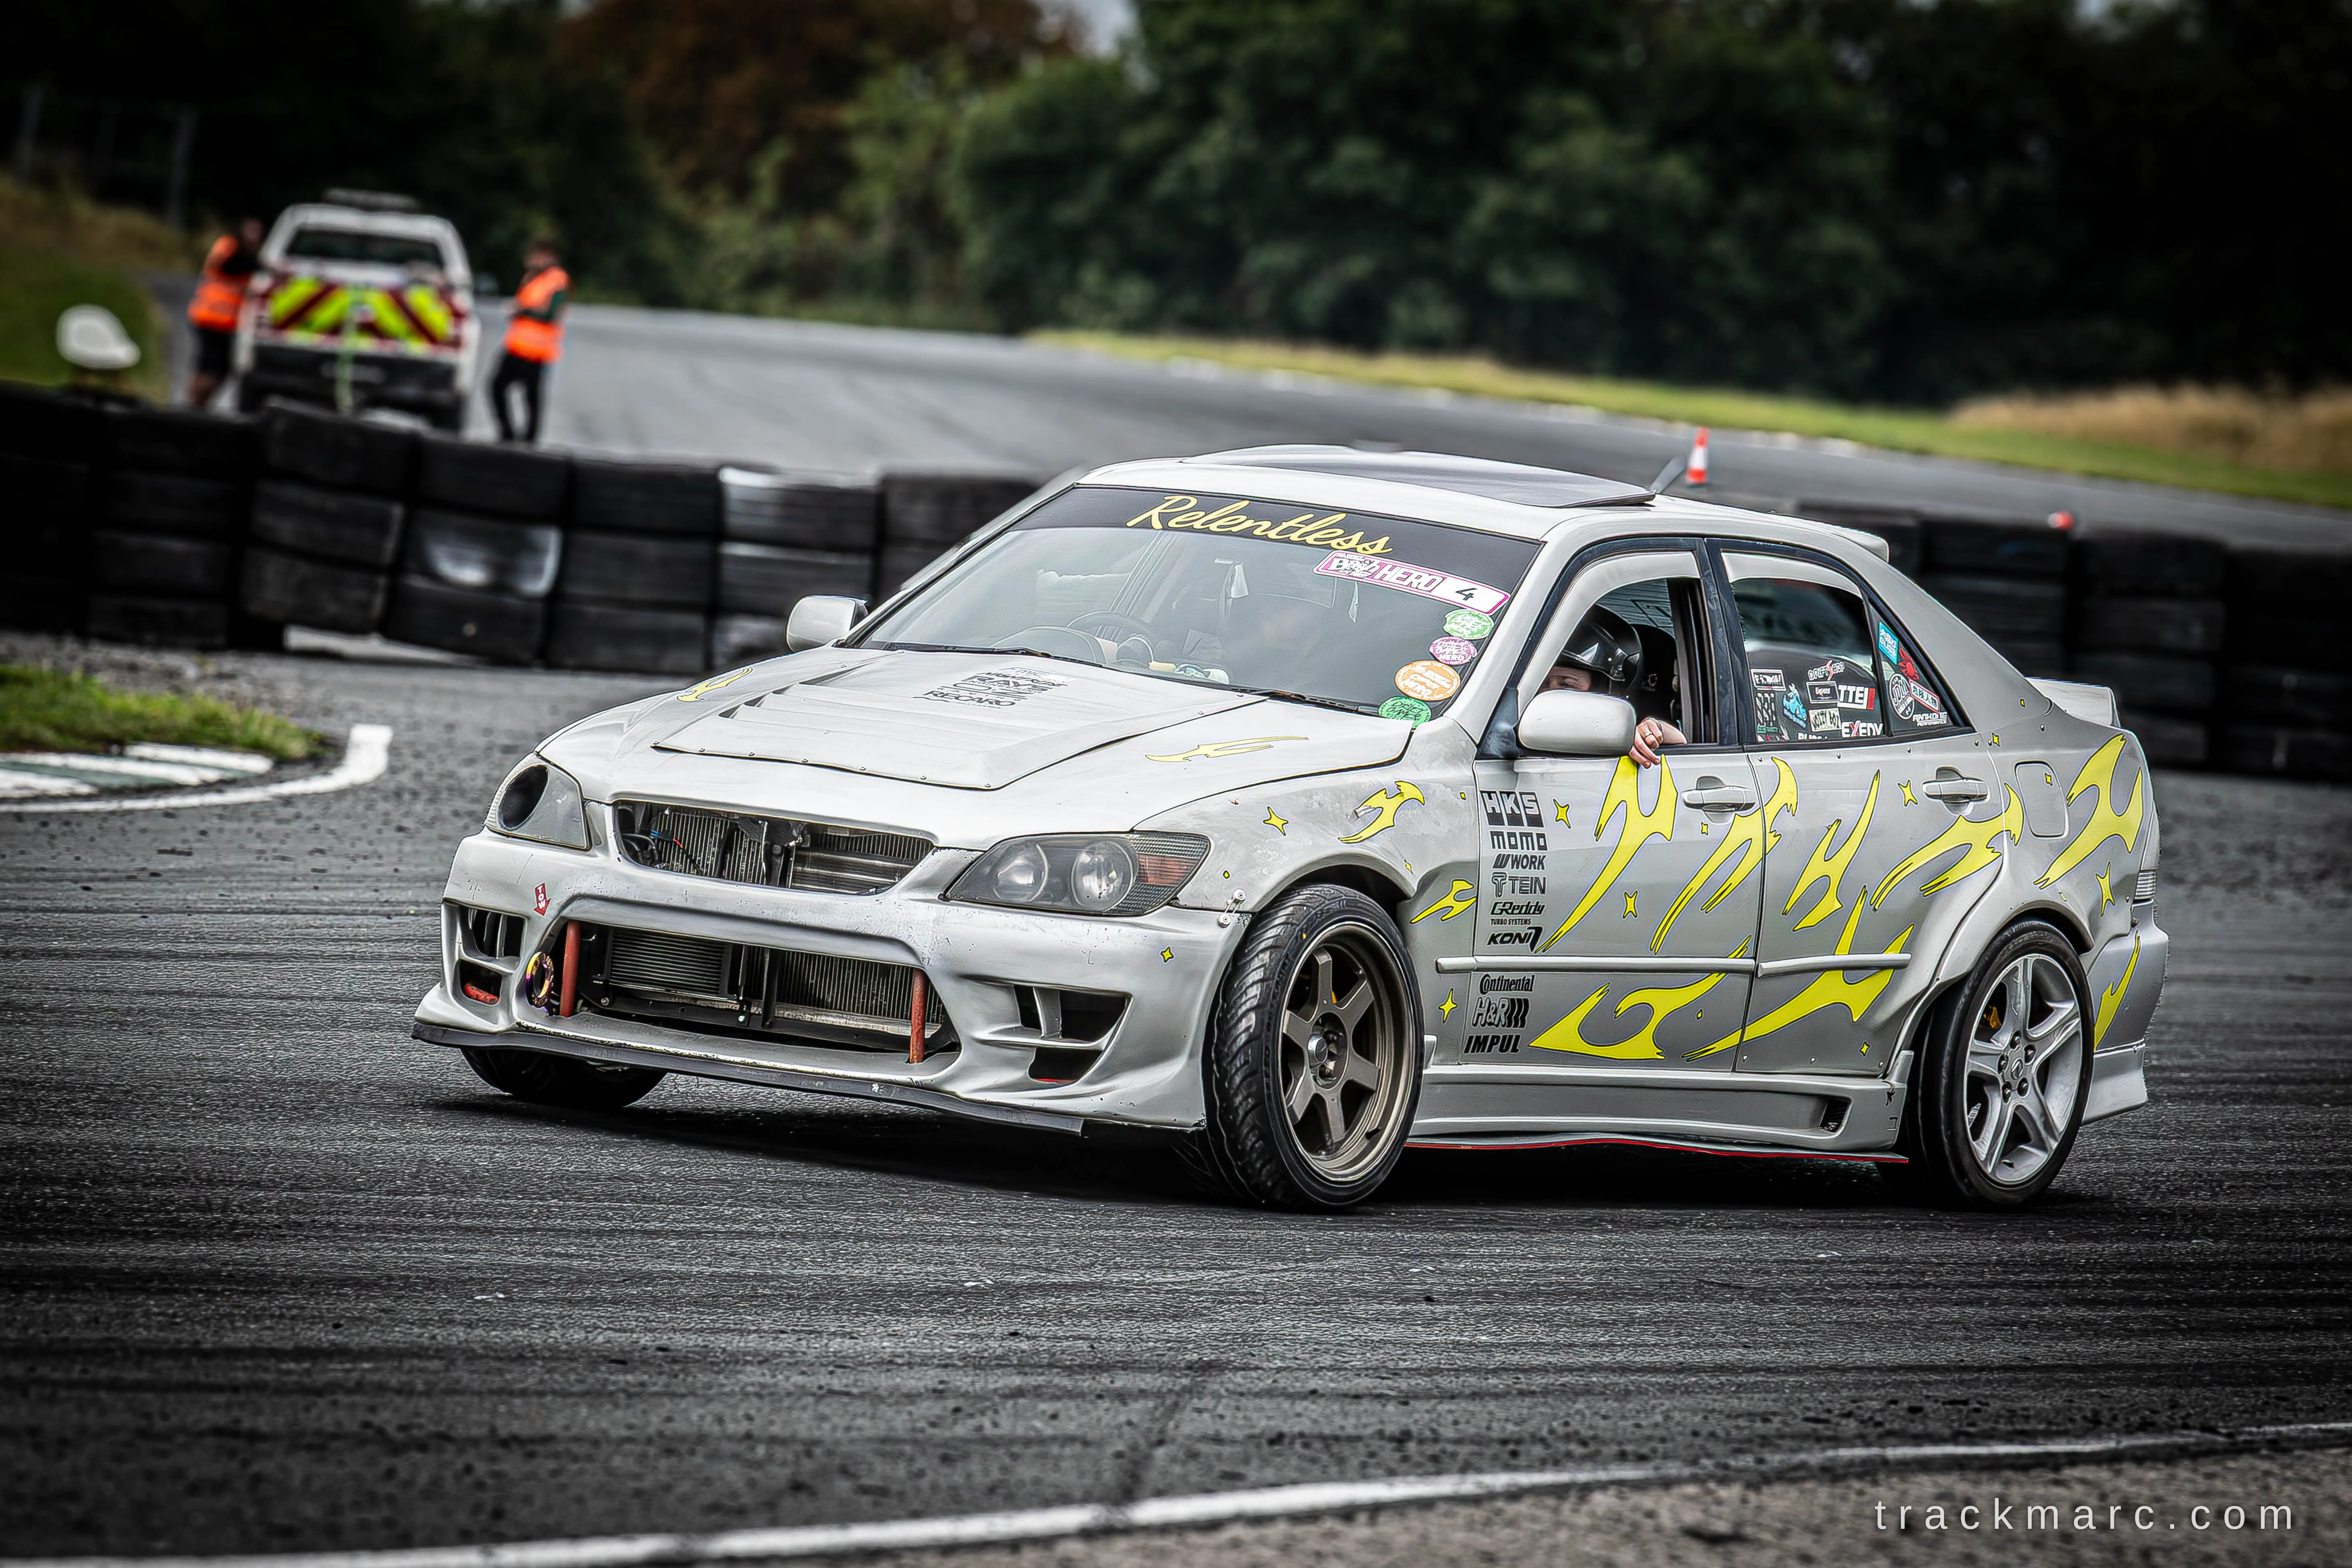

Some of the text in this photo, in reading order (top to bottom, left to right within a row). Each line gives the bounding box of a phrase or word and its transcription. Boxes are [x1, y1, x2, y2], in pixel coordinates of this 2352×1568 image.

[1126, 495, 1393, 555] Relentless
[1373, 565, 1445, 591] HERO
[1455, 588, 1478, 601] 4
[961, 675, 1054, 691] RAYS
[923, 690, 1016, 706] RECARO
[1838, 685, 1864, 704] TTE
[1481, 791, 1542, 820] HKS
[1511, 854, 1546, 870] WORK
[1508, 876, 1546, 895] TEIN
[537, 885, 546, 910] TOW
[1487, 930, 1536, 947] KONI
[1480, 973, 1535, 995] Continental
[1472, 996, 1510, 1028] H&R
[1464, 1034, 1521, 1053] IMPUL
